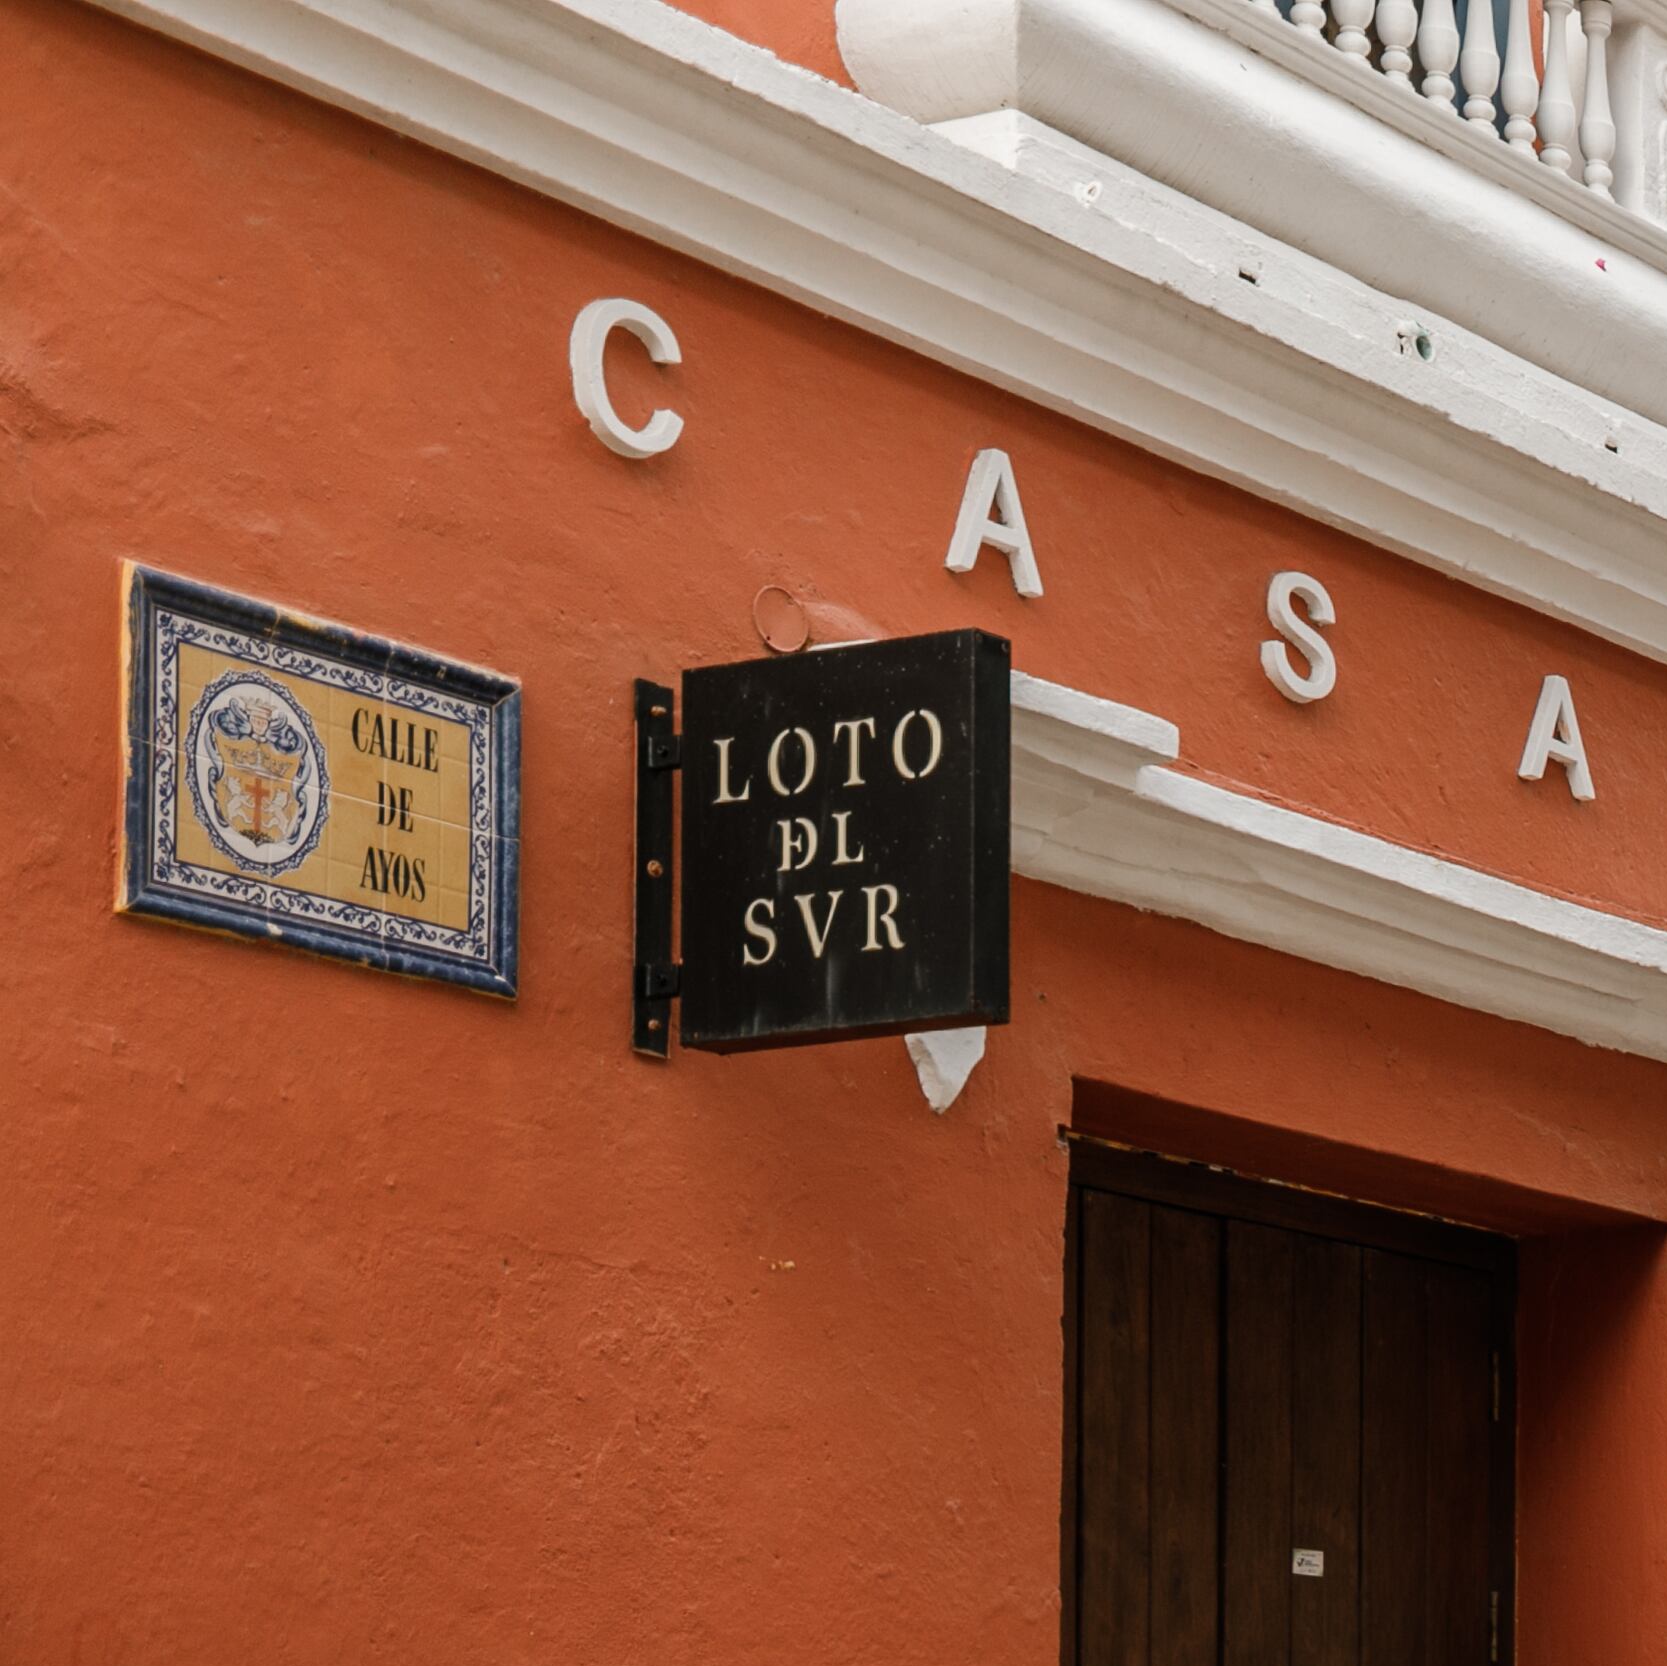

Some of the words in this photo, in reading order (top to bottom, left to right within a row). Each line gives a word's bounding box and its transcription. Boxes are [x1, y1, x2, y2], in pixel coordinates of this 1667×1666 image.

[570, 297, 1596, 801] CASA
[351, 706, 440, 774] CALLE
[711, 708, 944, 805] LOTO
[377, 781, 415, 834] DE
[359, 847, 427, 904] AYOS
[741, 883, 906, 967] SVR
